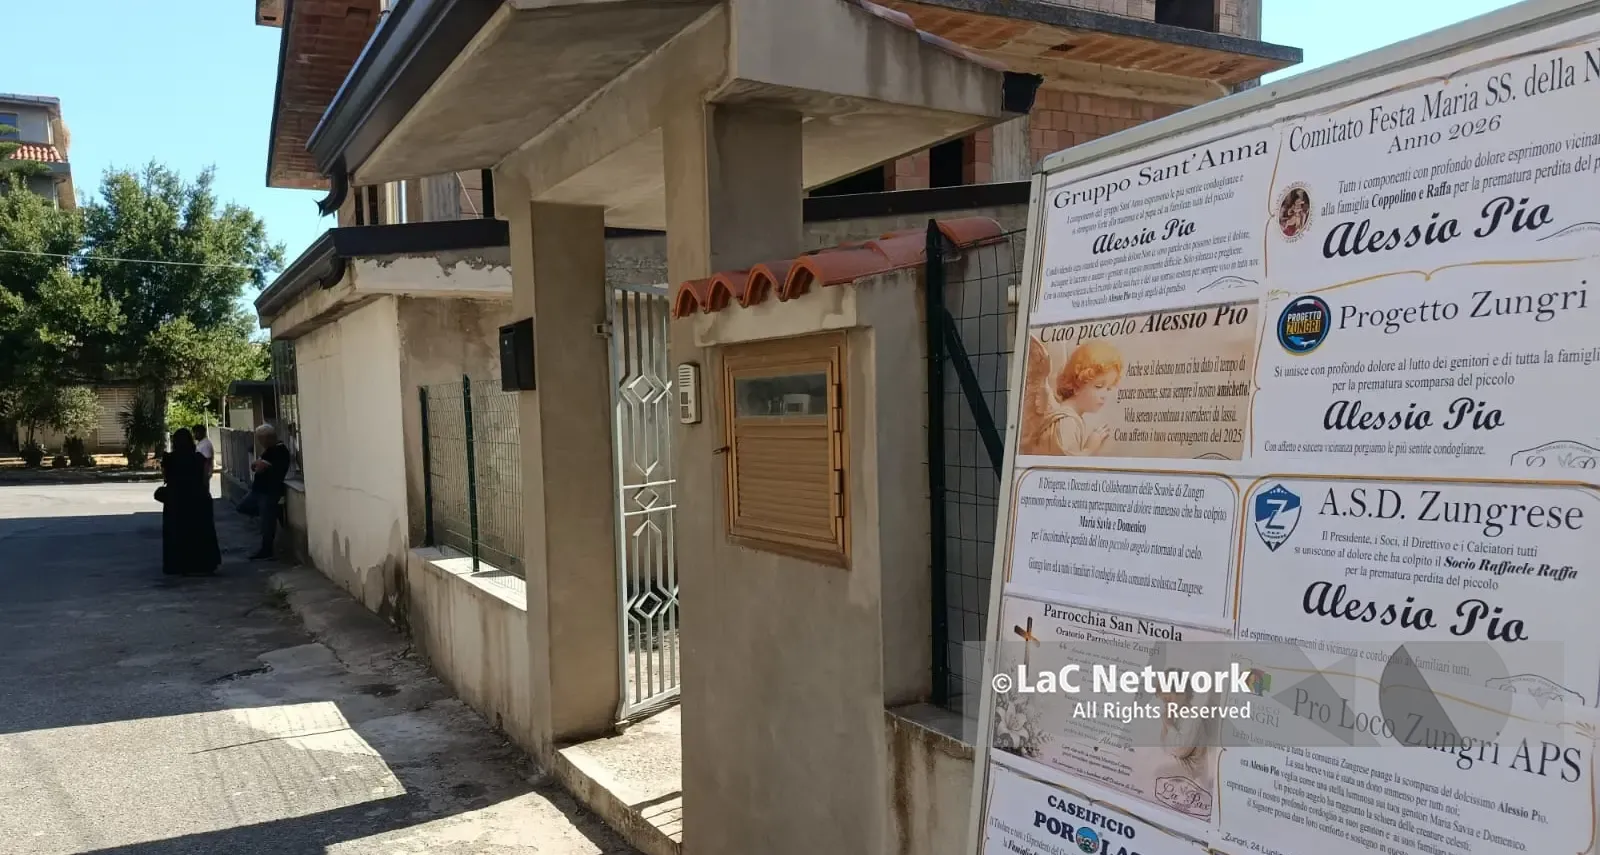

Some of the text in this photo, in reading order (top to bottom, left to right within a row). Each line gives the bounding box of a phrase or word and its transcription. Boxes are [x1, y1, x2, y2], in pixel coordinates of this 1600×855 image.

[1290, 119, 1363, 152] Comitato
[1369, 106, 1415, 134] Festa
[1421, 84, 1478, 122] Maria
[1486, 73, 1516, 106] SS.
[1525, 58, 1575, 97] della
[1388, 115, 1502, 154] Anno 2026
[1321, 202, 1336, 217] alla
[1337, 196, 1369, 214] famiglia
[1372, 189, 1417, 210] Coppolino
[1426, 181, 1451, 198] Raffa
[1453, 181, 1470, 198] per
[1472, 176, 1480, 191] la
[1482, 170, 1532, 193] prematura
[1534, 162, 1571, 184] perdita
[1574, 156, 1592, 173] del
[1339, 180, 1357, 194] Tutti
[1363, 171, 1411, 190] componenti
[1413, 168, 1429, 180] con
[1430, 156, 1473, 181] profondo
[1474, 151, 1505, 168] dolore
[1508, 142, 1562, 164] esprimono
[1054, 179, 1131, 209] Gruppo
[1093, 228, 1156, 255] Alessio
[1162, 220, 1195, 241] Pio
[1323, 198, 1554, 258] Alessio Pio
[1040, 307, 1248, 344] Ciao piccolo Alessio Pio
[1288, 310, 1321, 322] PROGETTO
[1340, 280, 1588, 334] Progetto Zungri
[1287, 320, 1320, 334] ZUNGRI
[1274, 366, 1283, 378] Si
[1284, 365, 1309, 377] unisce
[1311, 367, 1325, 376] con
[1327, 362, 1366, 378] profondo
[1368, 360, 1396, 372] dolore
[1398, 358, 1407, 371] al
[1409, 358, 1430, 370] lutto
[1432, 356, 1448, 369] dei
[1450, 354, 1489, 372] genitori
[1492, 357, 1499, 367] e
[1501, 352, 1512, 366] di
[1516, 353, 1540, 365] tutta
[1544, 350, 1554, 364] la
[1332, 372, 1515, 394] per la prematura scomparsa del piccolo
[1324, 397, 1505, 430] Alessio Pio
[1319, 488, 1584, 538] A.S.D. Zungrese
[1322, 531, 1328, 541] Il
[1403, 536, 1409, 547] il
[1412, 537, 1451, 550] Direttivo
[1453, 543, 1458, 551] e
[1467, 541, 1514, 556] Calciatori
[1517, 546, 1538, 557] tutti
[1294, 546, 1578, 581] si uniscono al dolore che ha colpito il Socio Raffaele Raffa
[1345, 566, 1499, 590] per la prematura perdita del piccolo
[1044, 604, 1182, 642] Parrocchia San Nicola
[1303, 582, 1528, 643] Alessio Pio
[1293, 688, 1331, 724] Pro
[1339, 698, 1395, 739] Loco
[1404, 712, 1500, 770] Zungri
[1511, 738, 1581, 783] APS
[1048, 795, 1135, 839] CASEIFICIO
